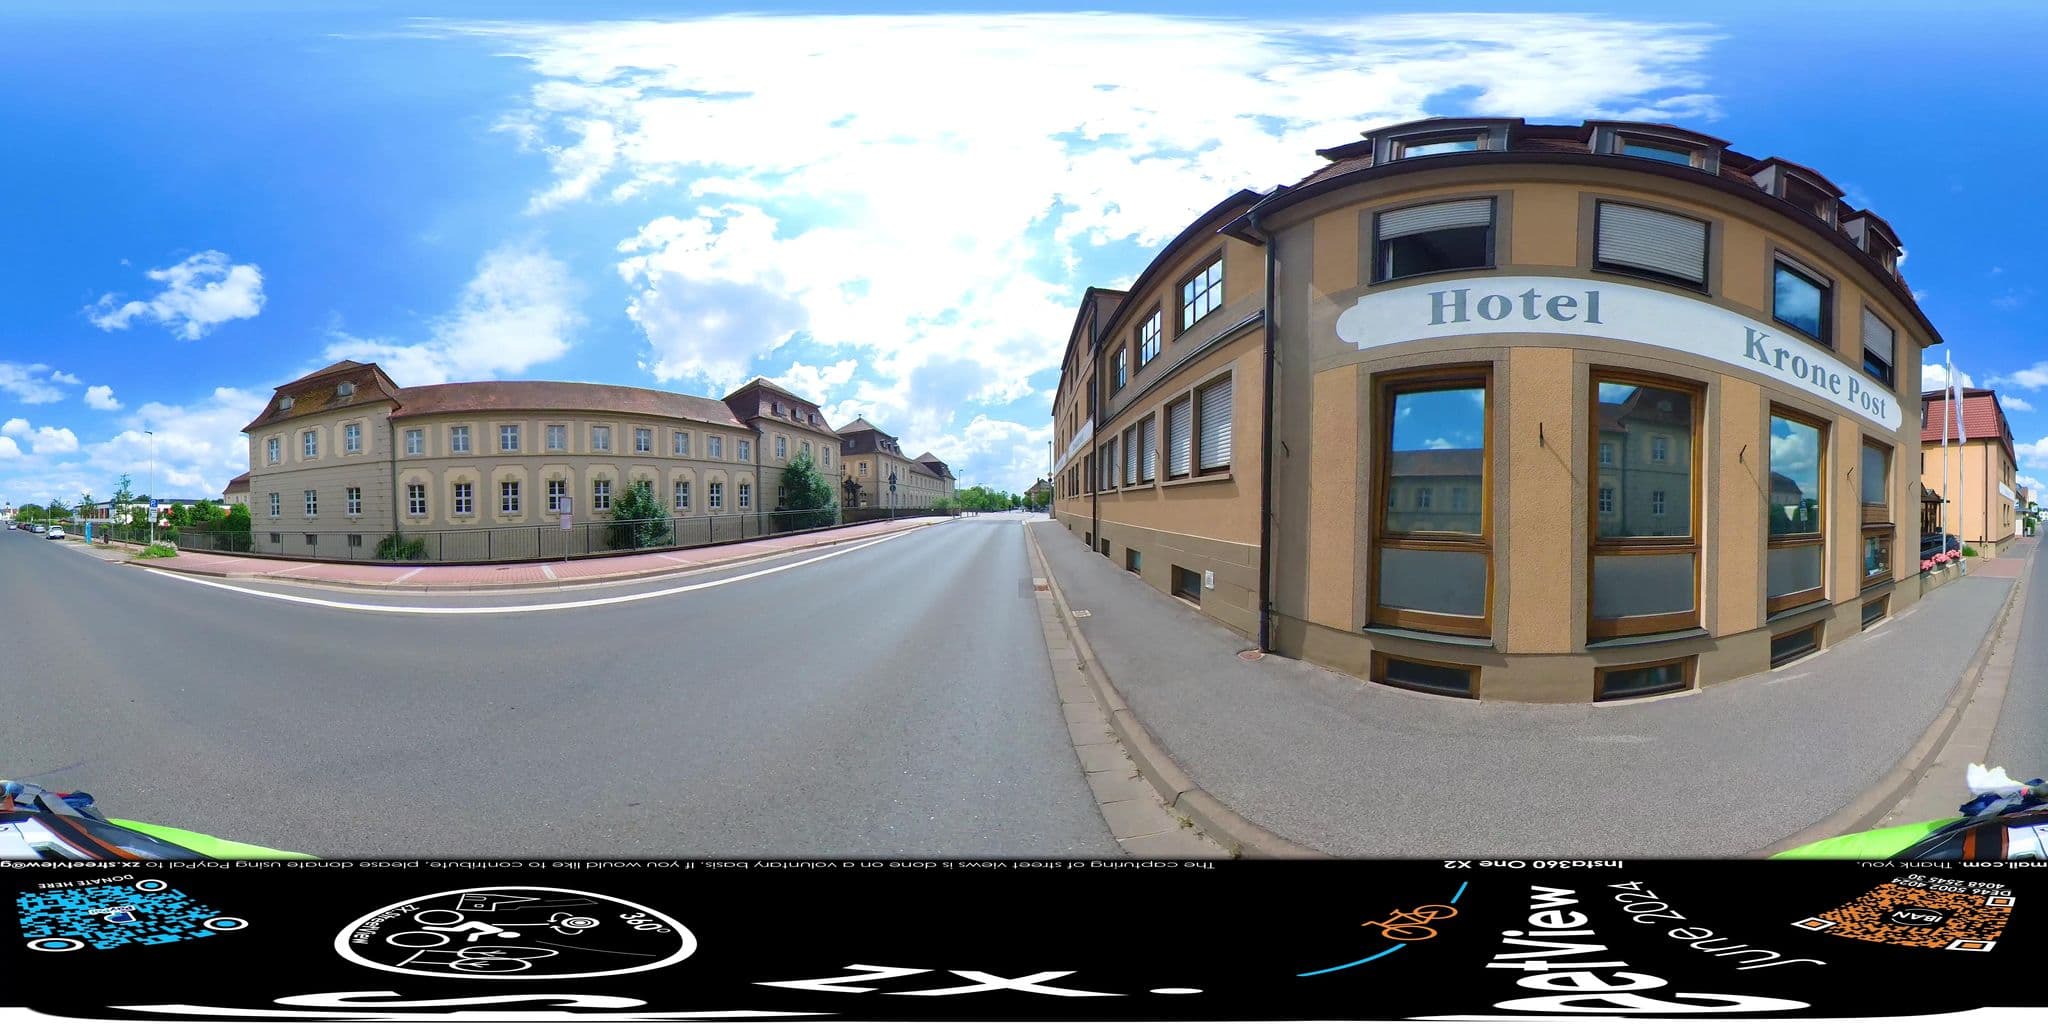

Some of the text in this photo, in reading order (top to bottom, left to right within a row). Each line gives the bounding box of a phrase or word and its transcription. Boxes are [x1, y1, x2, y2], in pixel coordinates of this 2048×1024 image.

[1427, 288, 1603, 327] Hotel
[1743, 325, 1888, 419] Krone Post
